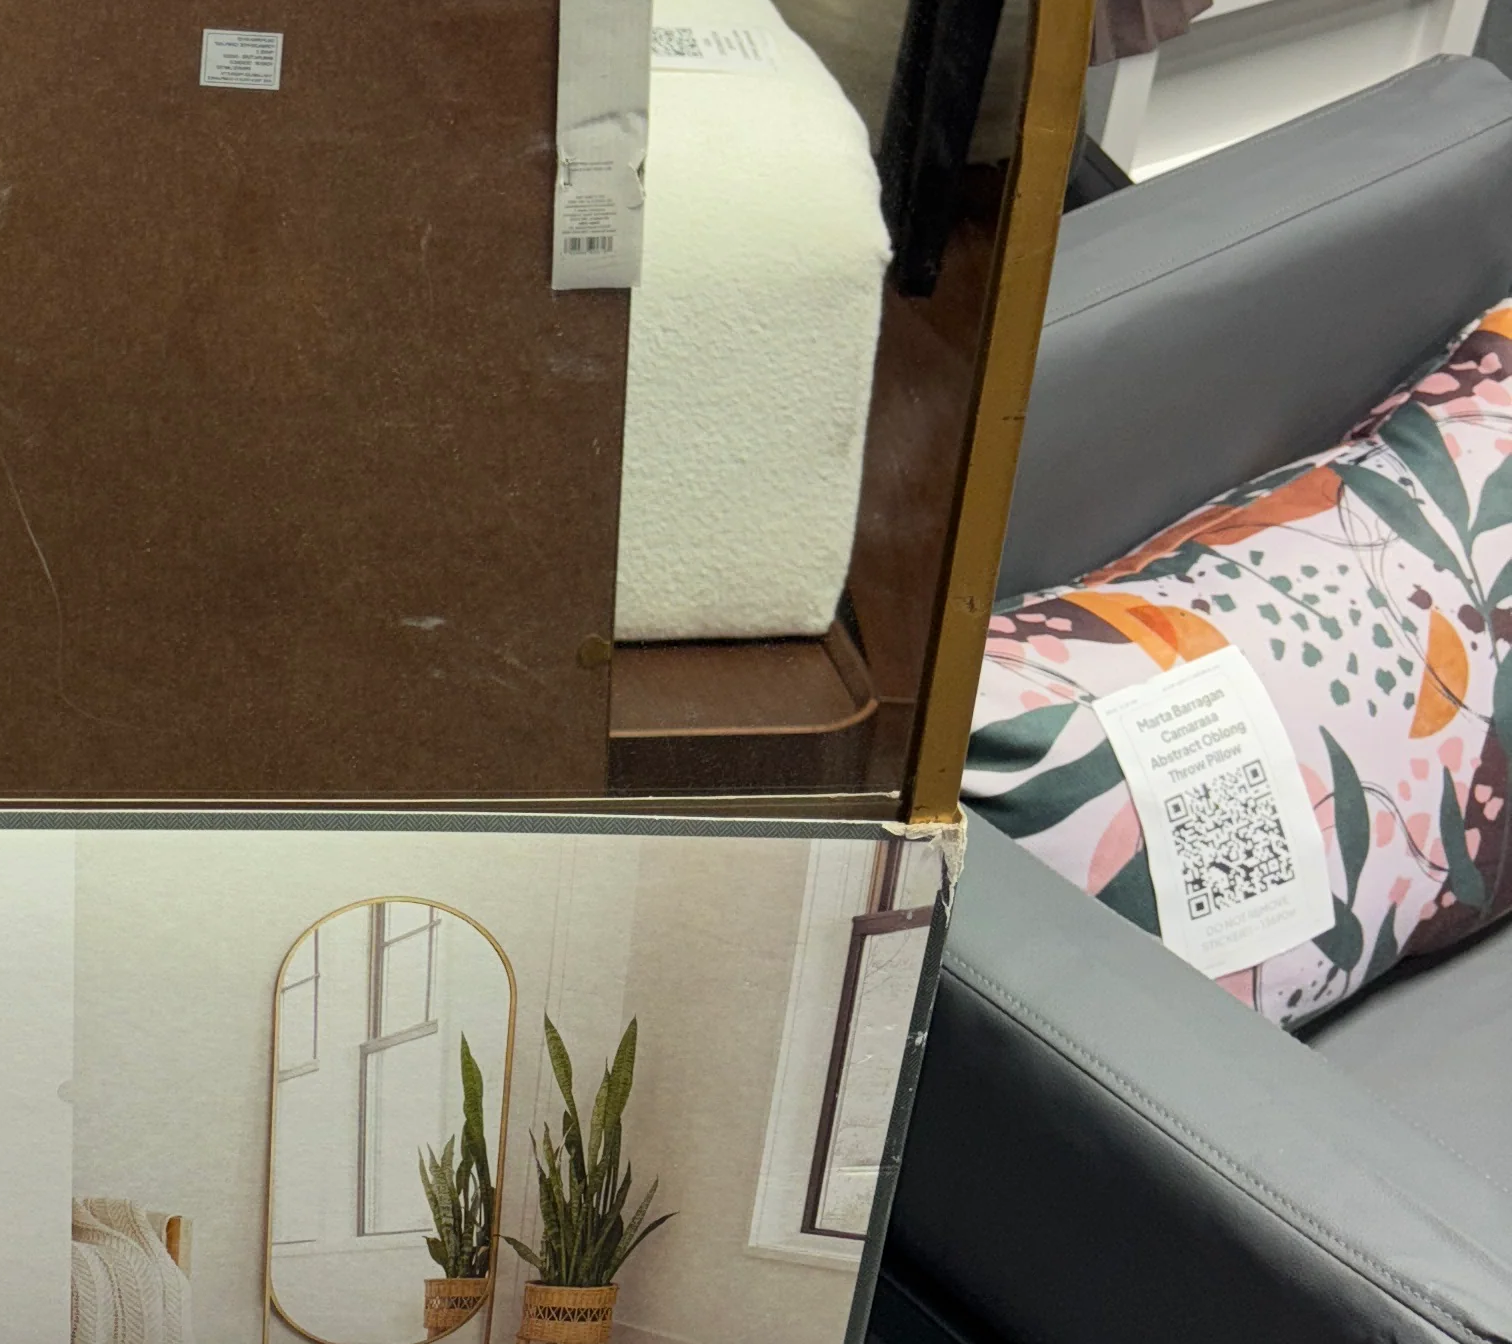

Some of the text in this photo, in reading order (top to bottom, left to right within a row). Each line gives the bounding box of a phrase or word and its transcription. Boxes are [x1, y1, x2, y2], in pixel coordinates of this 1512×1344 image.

[1136, 688, 1225, 733] Marta Barragan
[1161, 711, 1219, 744] Camarasa
[1151, 721, 1247, 770] Abstract Oblong
[1168, 743, 1242, 783] Throw Pillow
